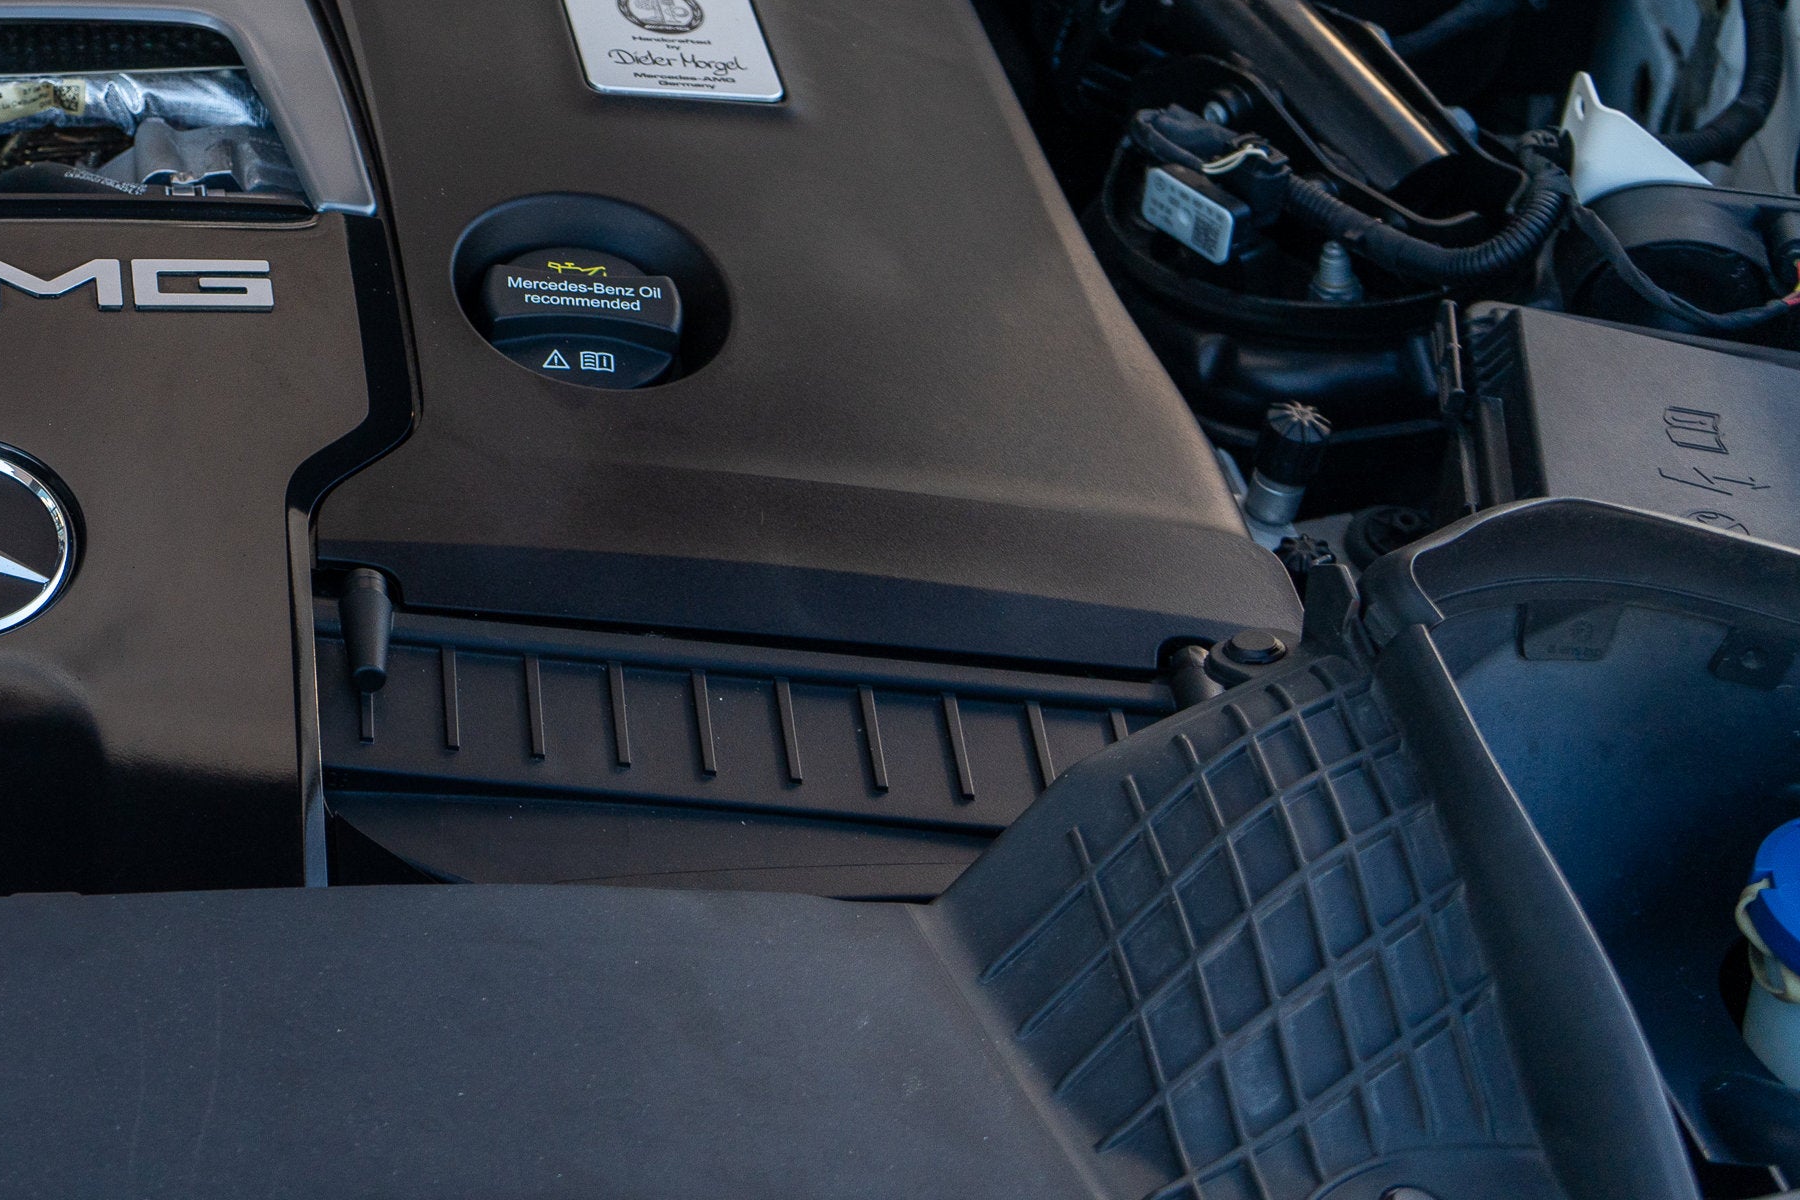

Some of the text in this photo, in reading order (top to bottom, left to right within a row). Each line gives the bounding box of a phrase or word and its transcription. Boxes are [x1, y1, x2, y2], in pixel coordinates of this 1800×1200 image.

[632, 35, 711, 45] Handcrafted
[633, 72, 736, 83] Mercedes-AMG
[658, 80, 715, 89] Germany
[507, 275, 662, 299] Mercedes-Benz Oil
[524, 293, 641, 311] recommended
